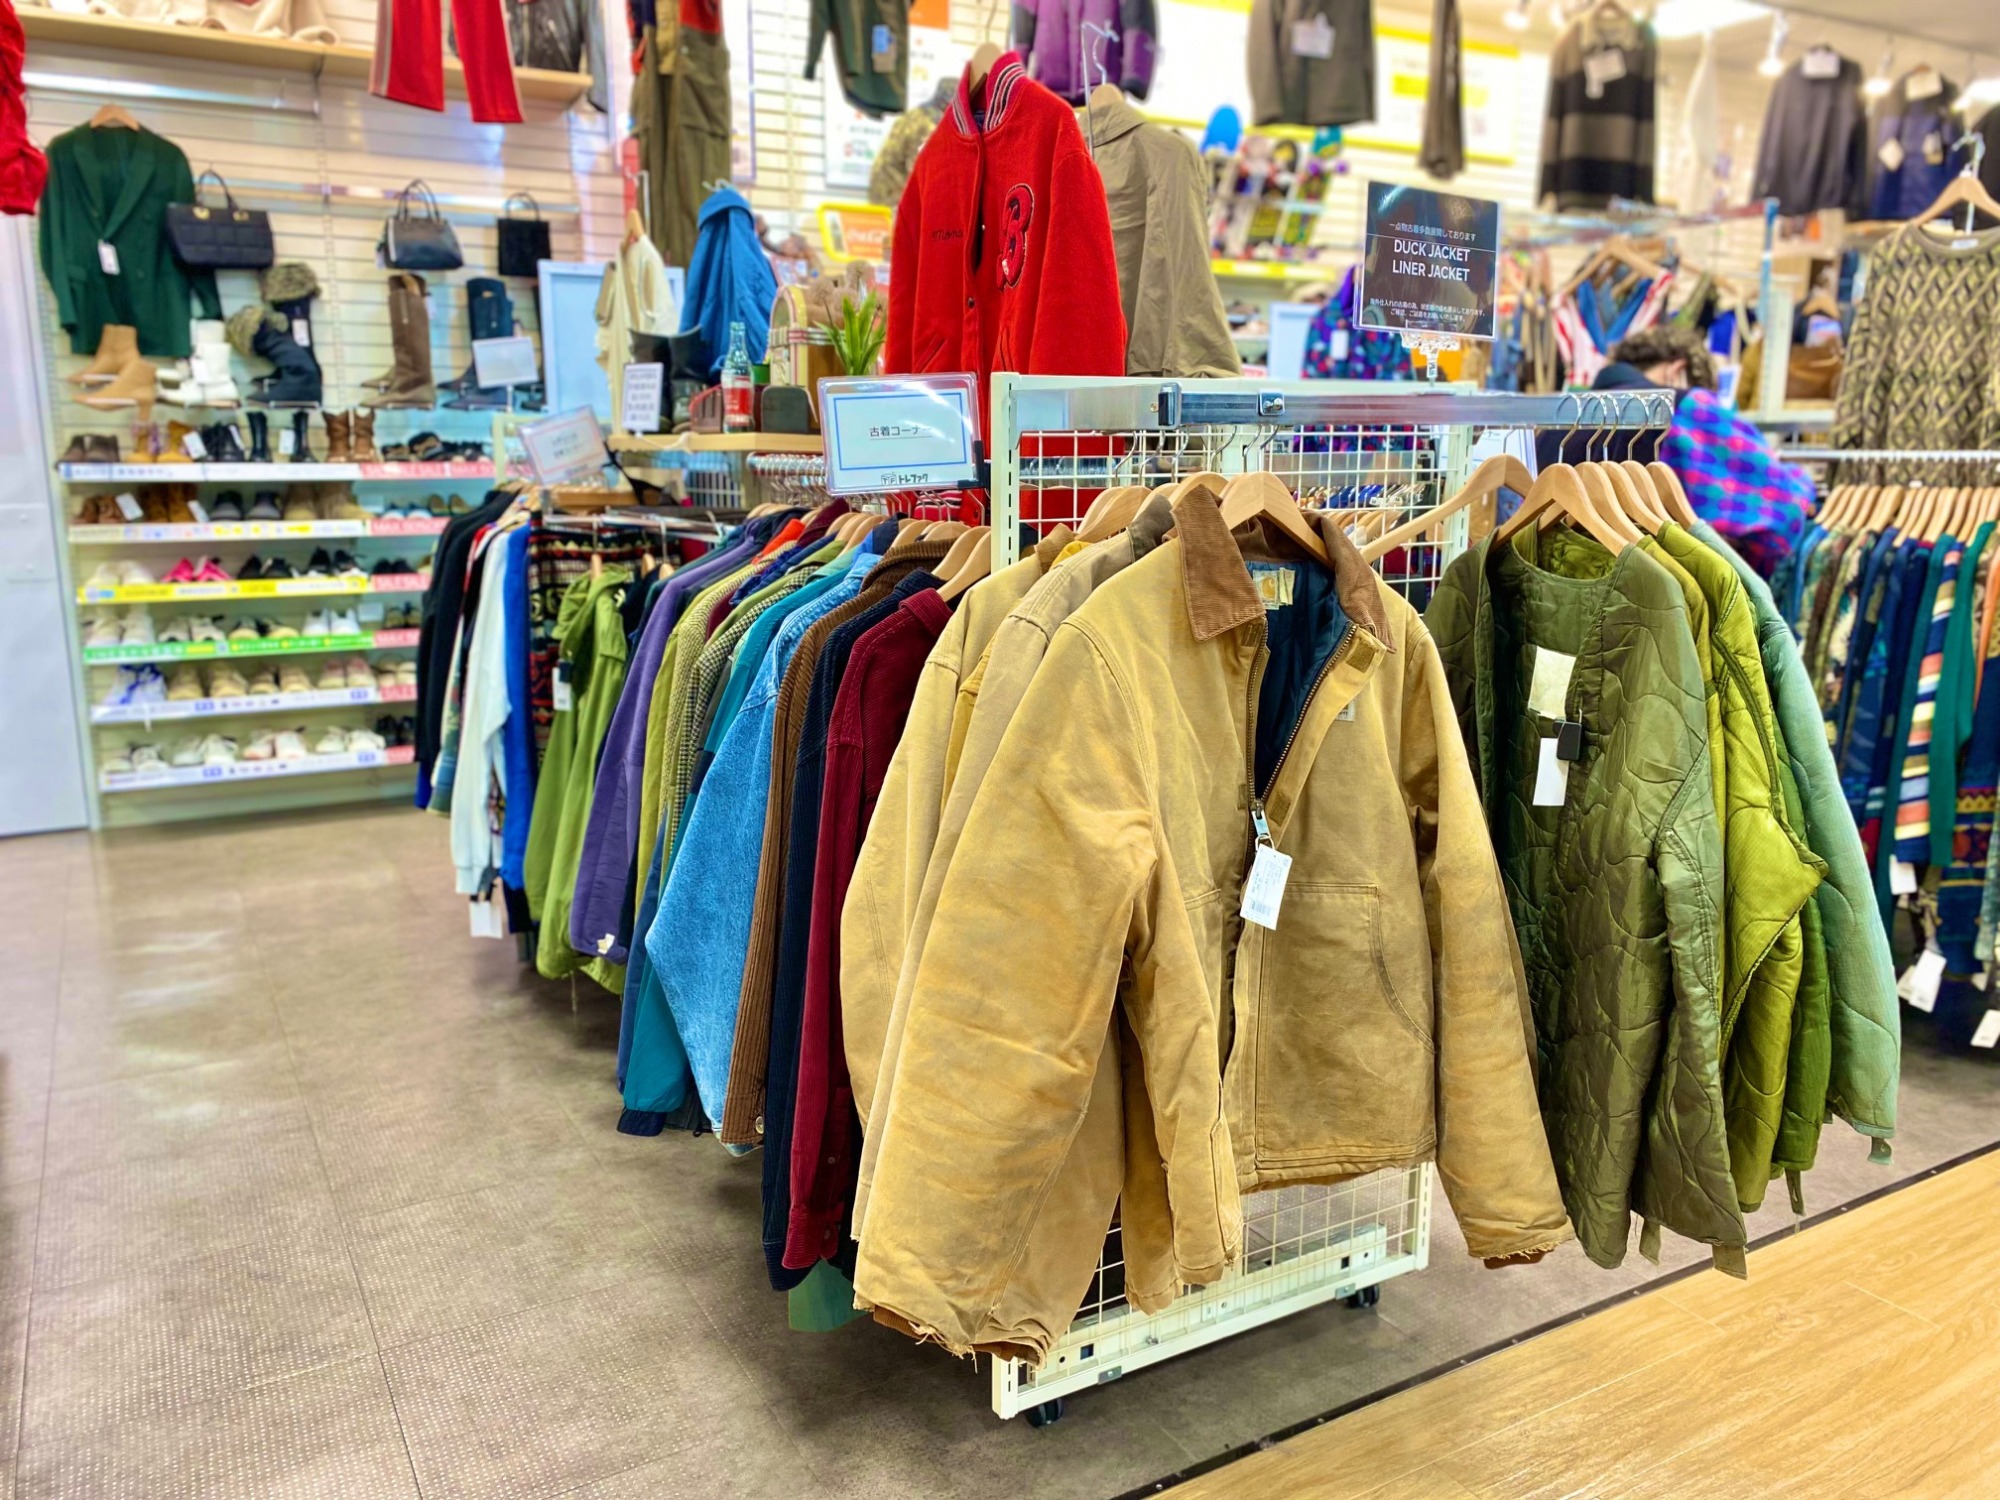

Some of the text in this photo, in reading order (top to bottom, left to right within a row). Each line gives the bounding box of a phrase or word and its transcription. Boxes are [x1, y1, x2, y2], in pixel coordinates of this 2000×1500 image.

[1394, 239, 1471, 262] DUCK JACKET
[1392, 260, 1470, 282] LINER JACKET
[869, 425, 933, 437] 古着コーナー
